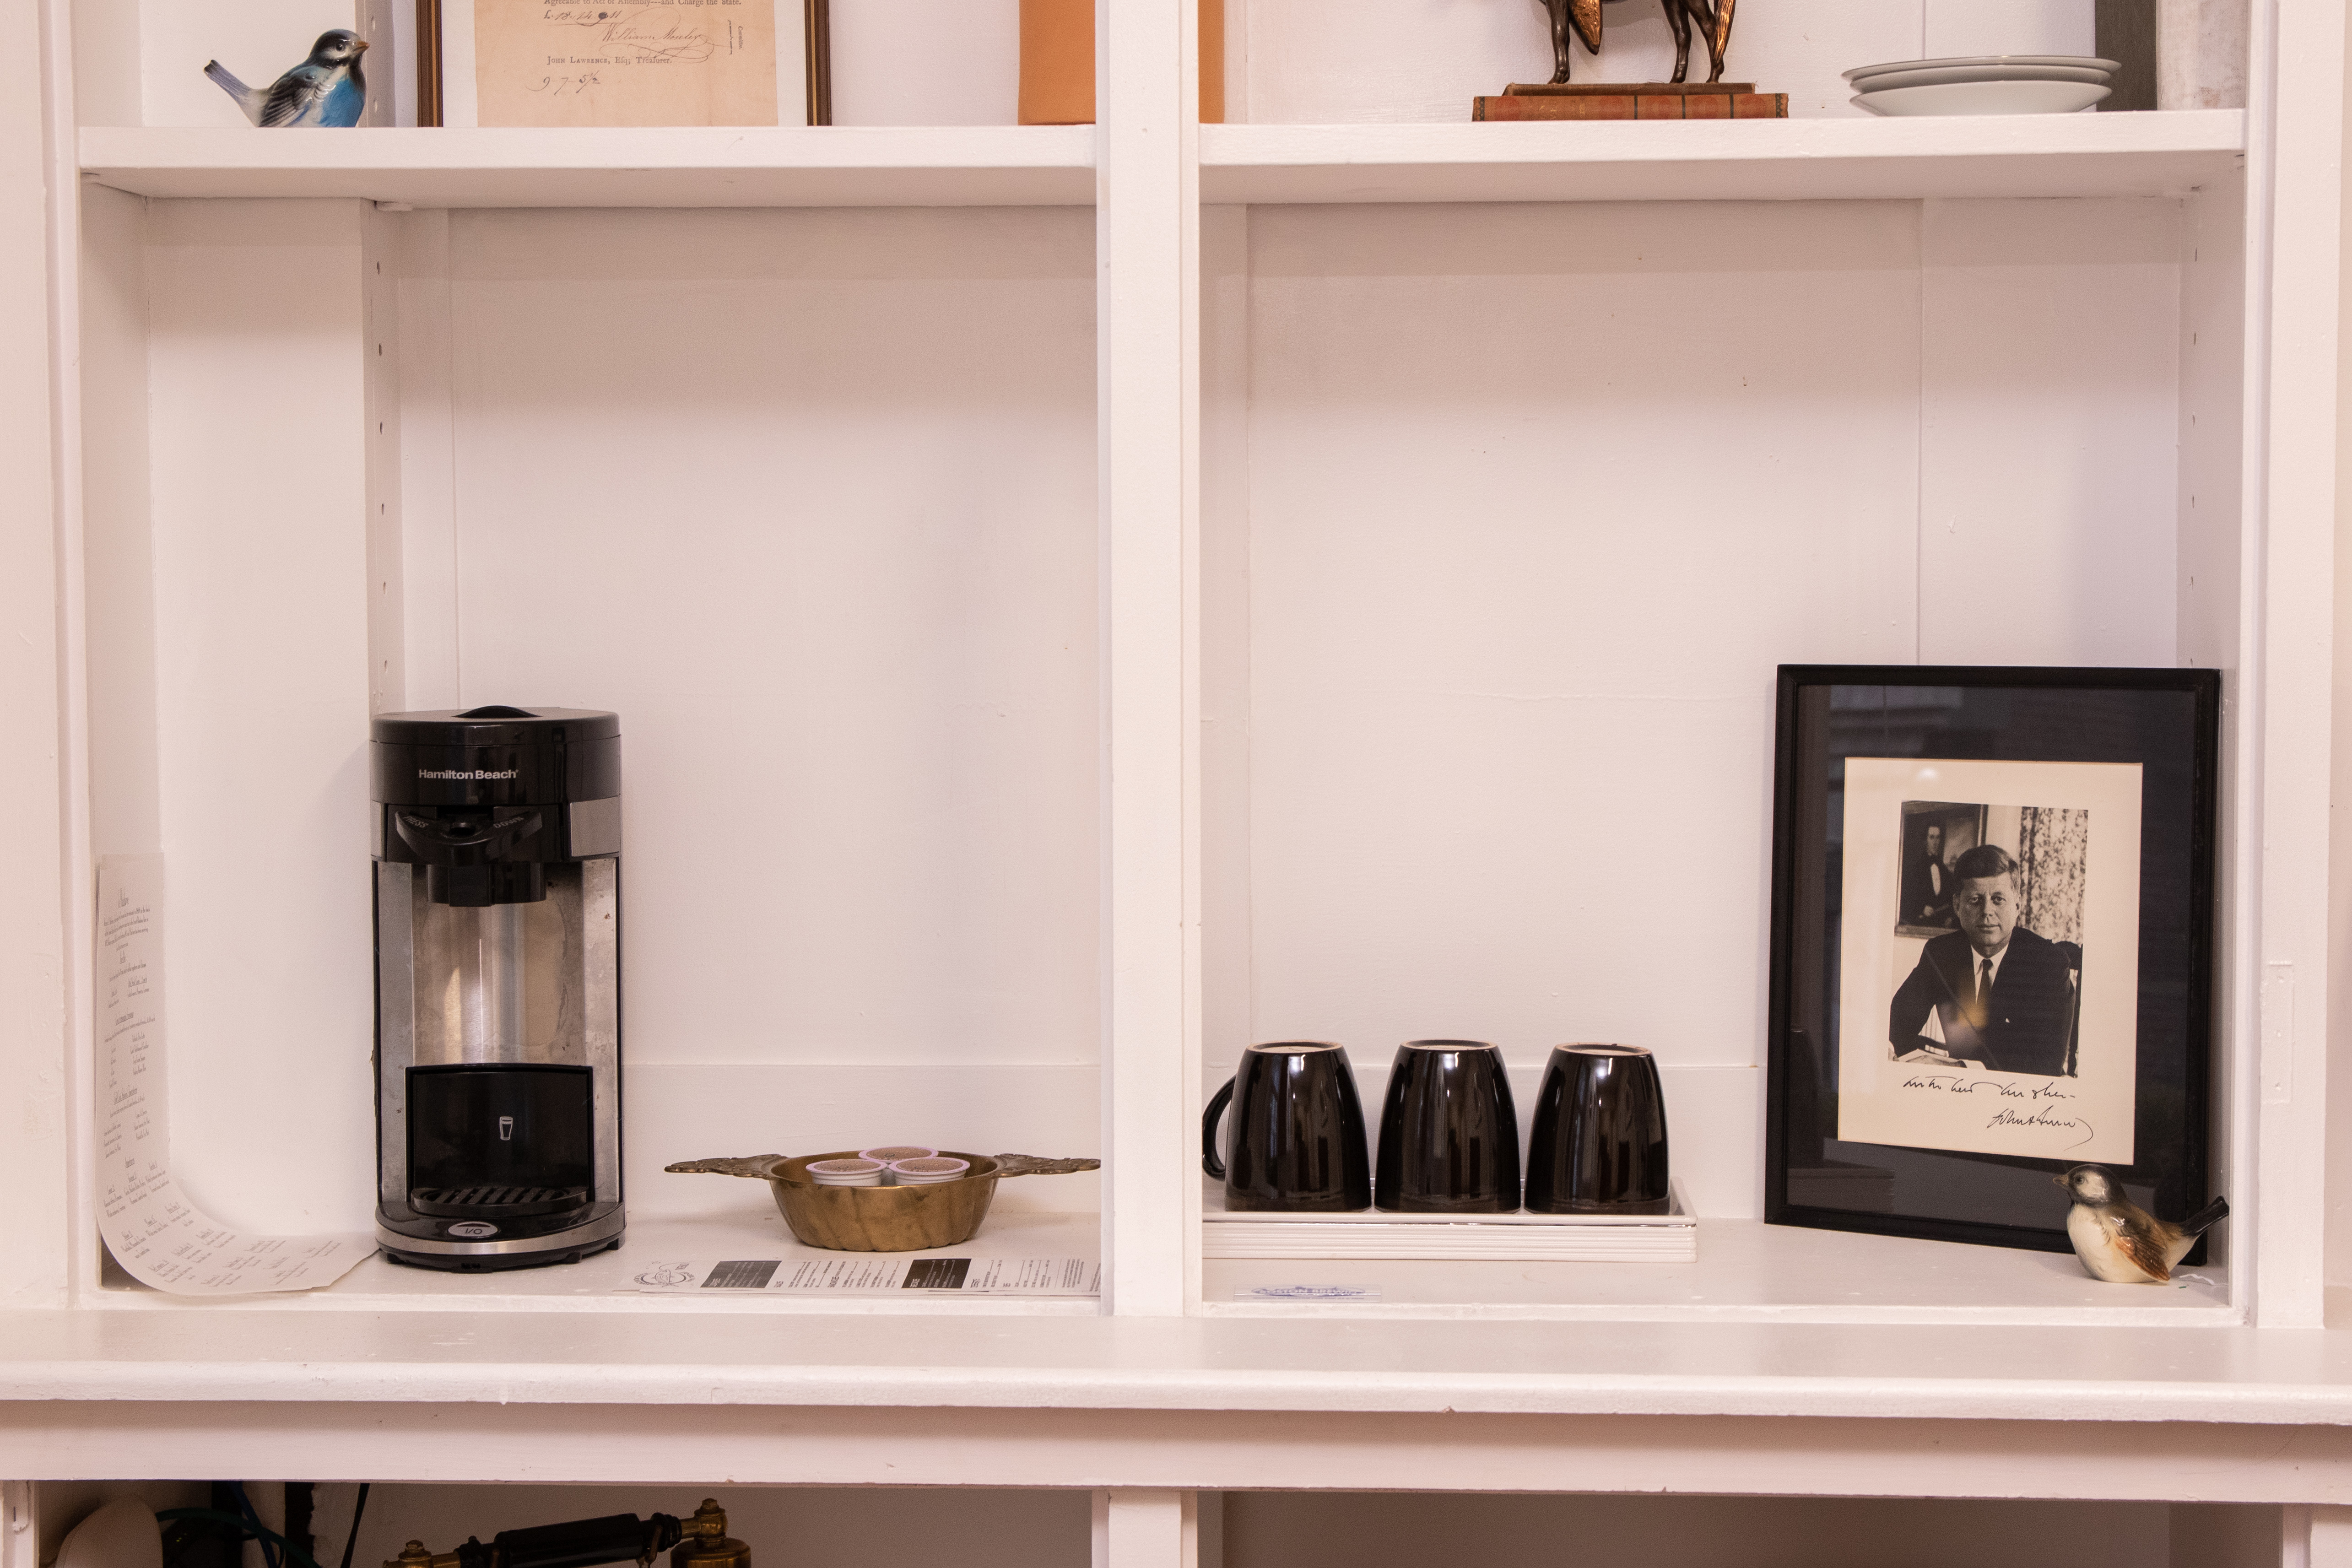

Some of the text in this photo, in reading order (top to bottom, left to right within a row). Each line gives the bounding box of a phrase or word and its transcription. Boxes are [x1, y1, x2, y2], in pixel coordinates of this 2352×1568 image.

[418, 769, 474, 780] Hamilton
[402, 816, 524, 829] PRESS DOWN
